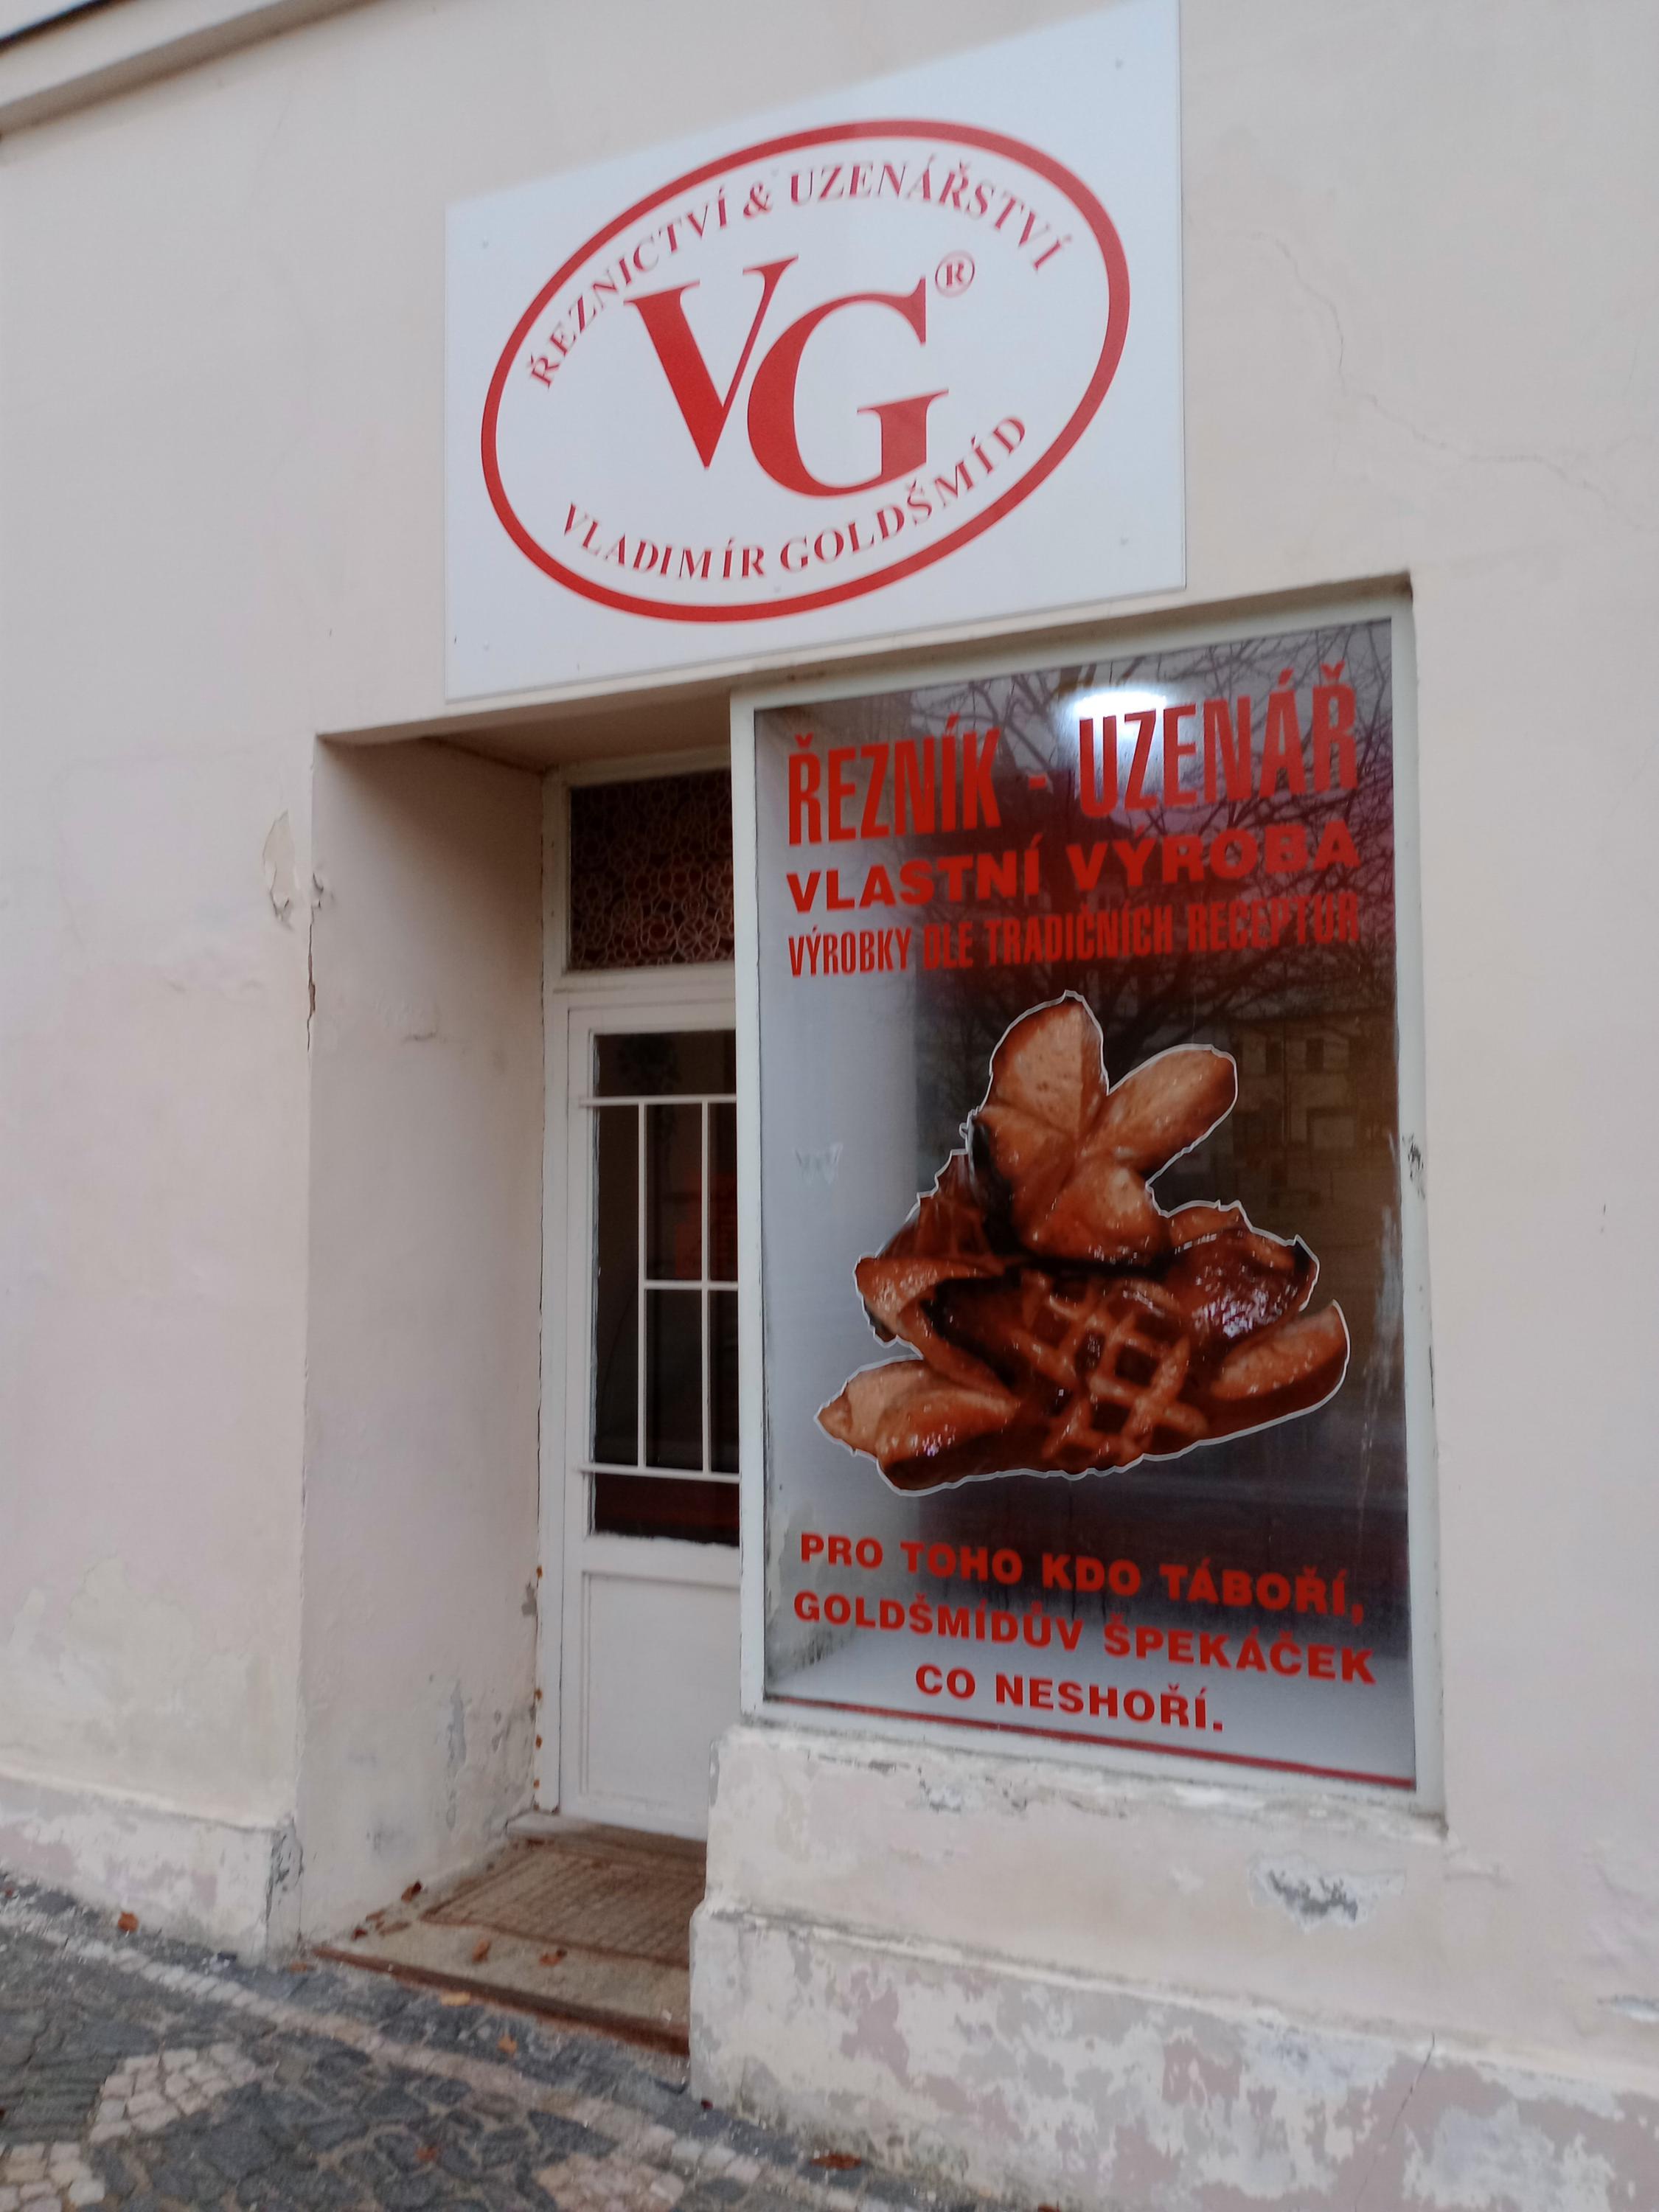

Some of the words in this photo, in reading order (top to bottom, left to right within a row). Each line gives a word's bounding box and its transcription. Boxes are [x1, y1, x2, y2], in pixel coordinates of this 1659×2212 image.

[526, 181, 728, 389] ŘEZNICTVÍ
[742, 181, 772, 219] &
[790, 154, 1071, 271] UZENÁŘSTVÍ
[622, 254, 950, 499] VG
[563, 501, 765, 580] VLADIMÍR
[779, 416, 1026, 572] GOLDŠMÍD
[788, 713, 1001, 846] ŘEZNÍK
[1079, 660, 1359, 818] UZENÁŘ
[787, 832, 1043, 914] VLASTNÍ
[1066, 819, 1362, 891] VÝROBA
[788, 925, 913, 978] VÝROBKY
[923, 923, 974, 971] DLE
[984, 900, 1173, 966] TRADIČNÍCH
[1188, 891, 1359, 953] RECEPTUR
[800, 1532, 884, 1571] PRO
[900, 1540, 1023, 1585] TOHO
[1041, 1552, 1142, 1597] KDO
[1158, 1556, 1364, 1627] TÁBOŘÍ,
[793, 1589, 1084, 1652] GOLDŠMÍDŮV
[1103, 1611, 1377, 1686] ŠPEKÁČEK
[915, 1663, 976, 1700] CO
[995, 1672, 1224, 1733] NESHOŘÍ.
